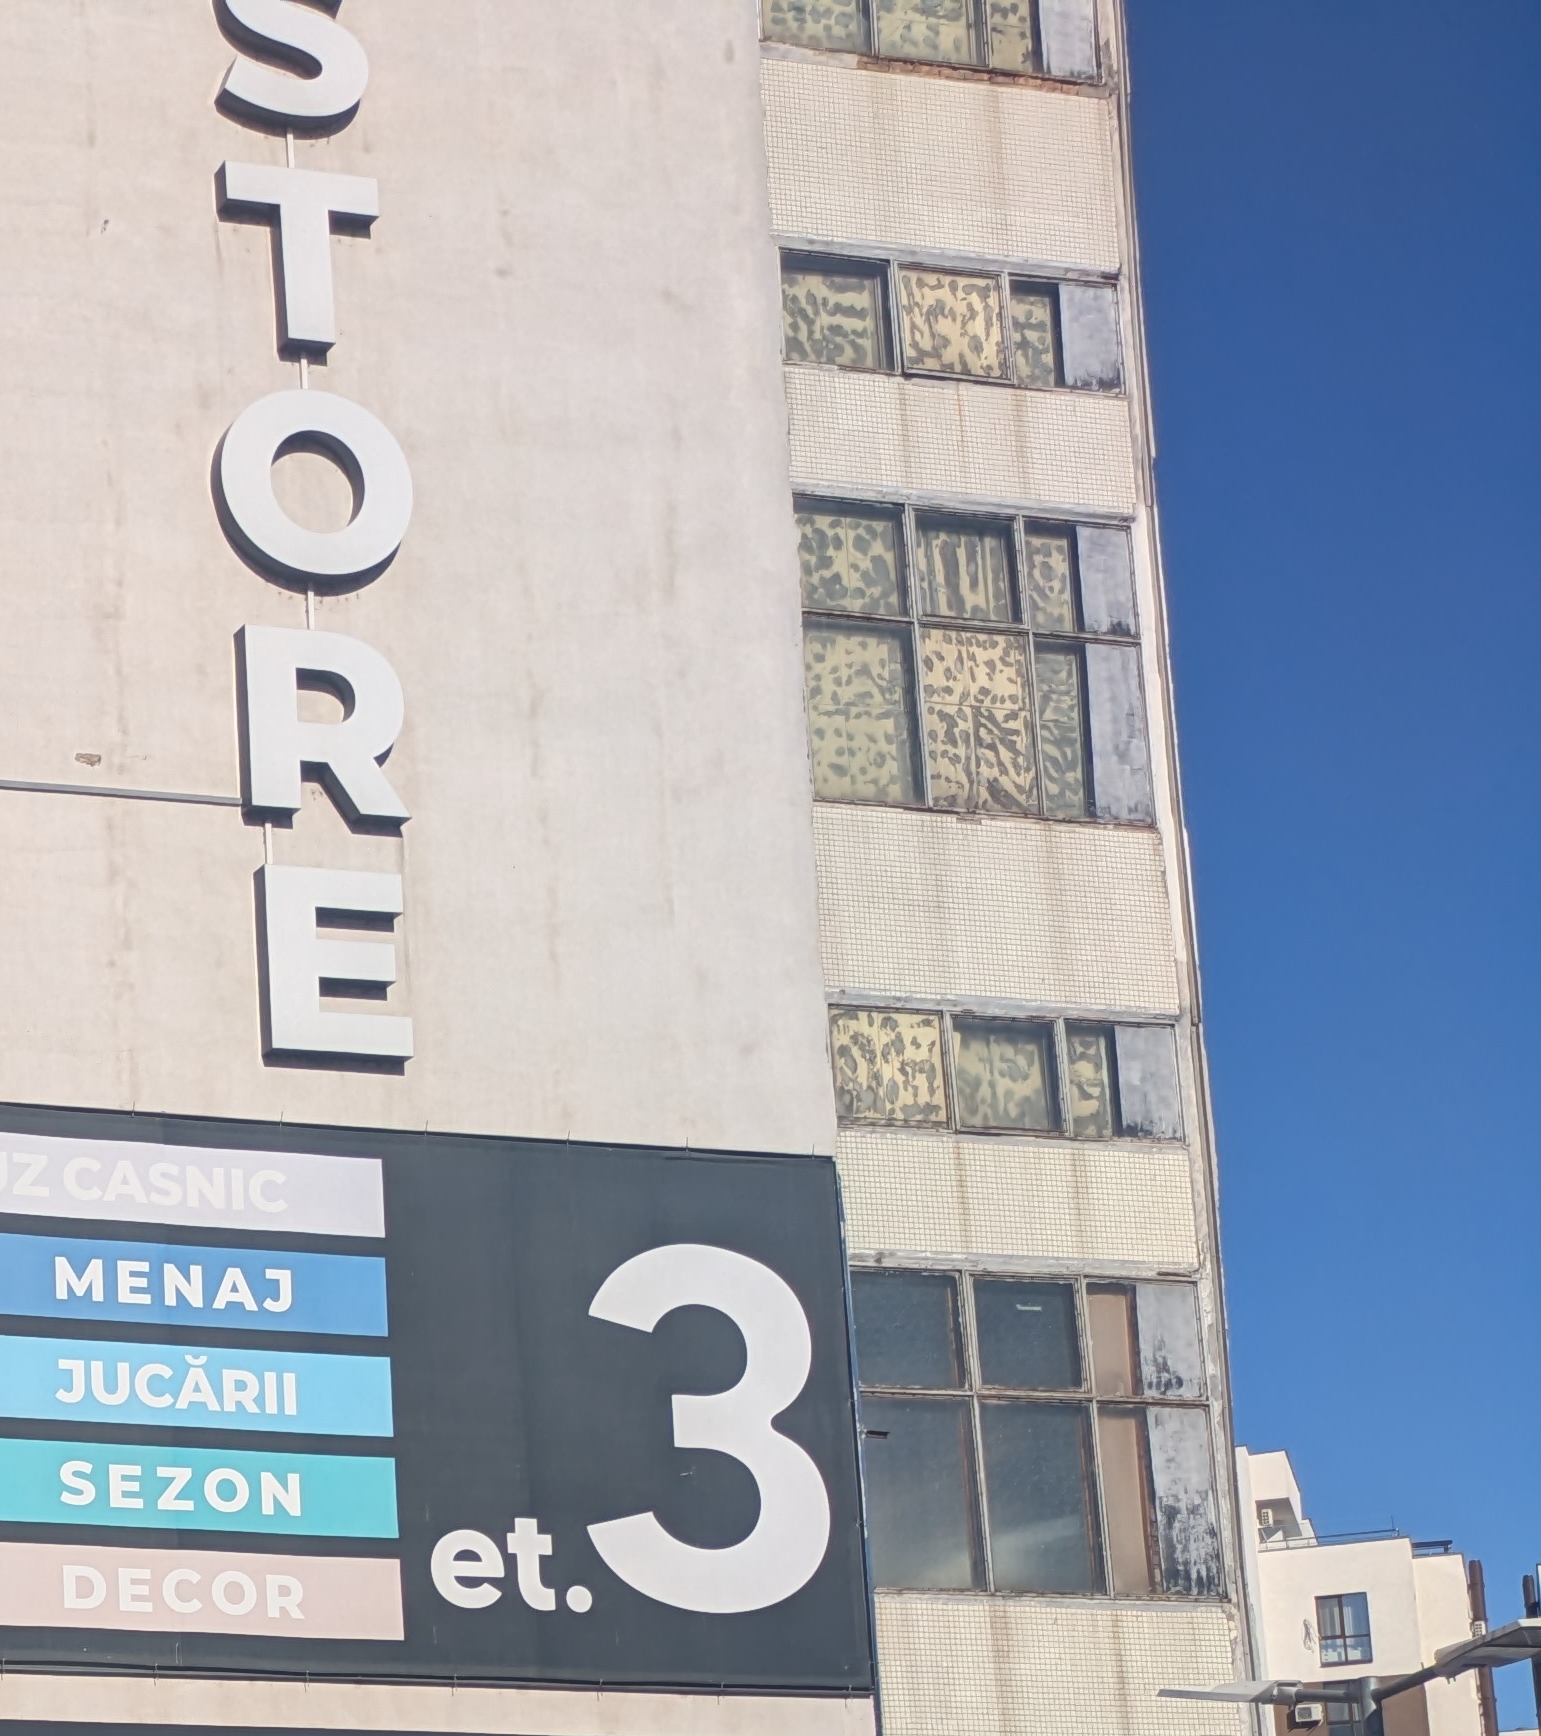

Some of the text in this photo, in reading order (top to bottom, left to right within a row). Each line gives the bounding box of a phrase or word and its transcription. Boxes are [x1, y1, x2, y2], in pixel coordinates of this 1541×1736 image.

[211, 0, 413, 1070] STORE
[74, 1153, 288, 1216] CASNIC
[54, 1254, 294, 1315] MENAJ
[56, 1354, 298, 1418] JUCĂRII
[430, 1243, 832, 1615] et. 3
[59, 1459, 303, 1518] SEZON
[62, 1562, 305, 1621] DECOR
